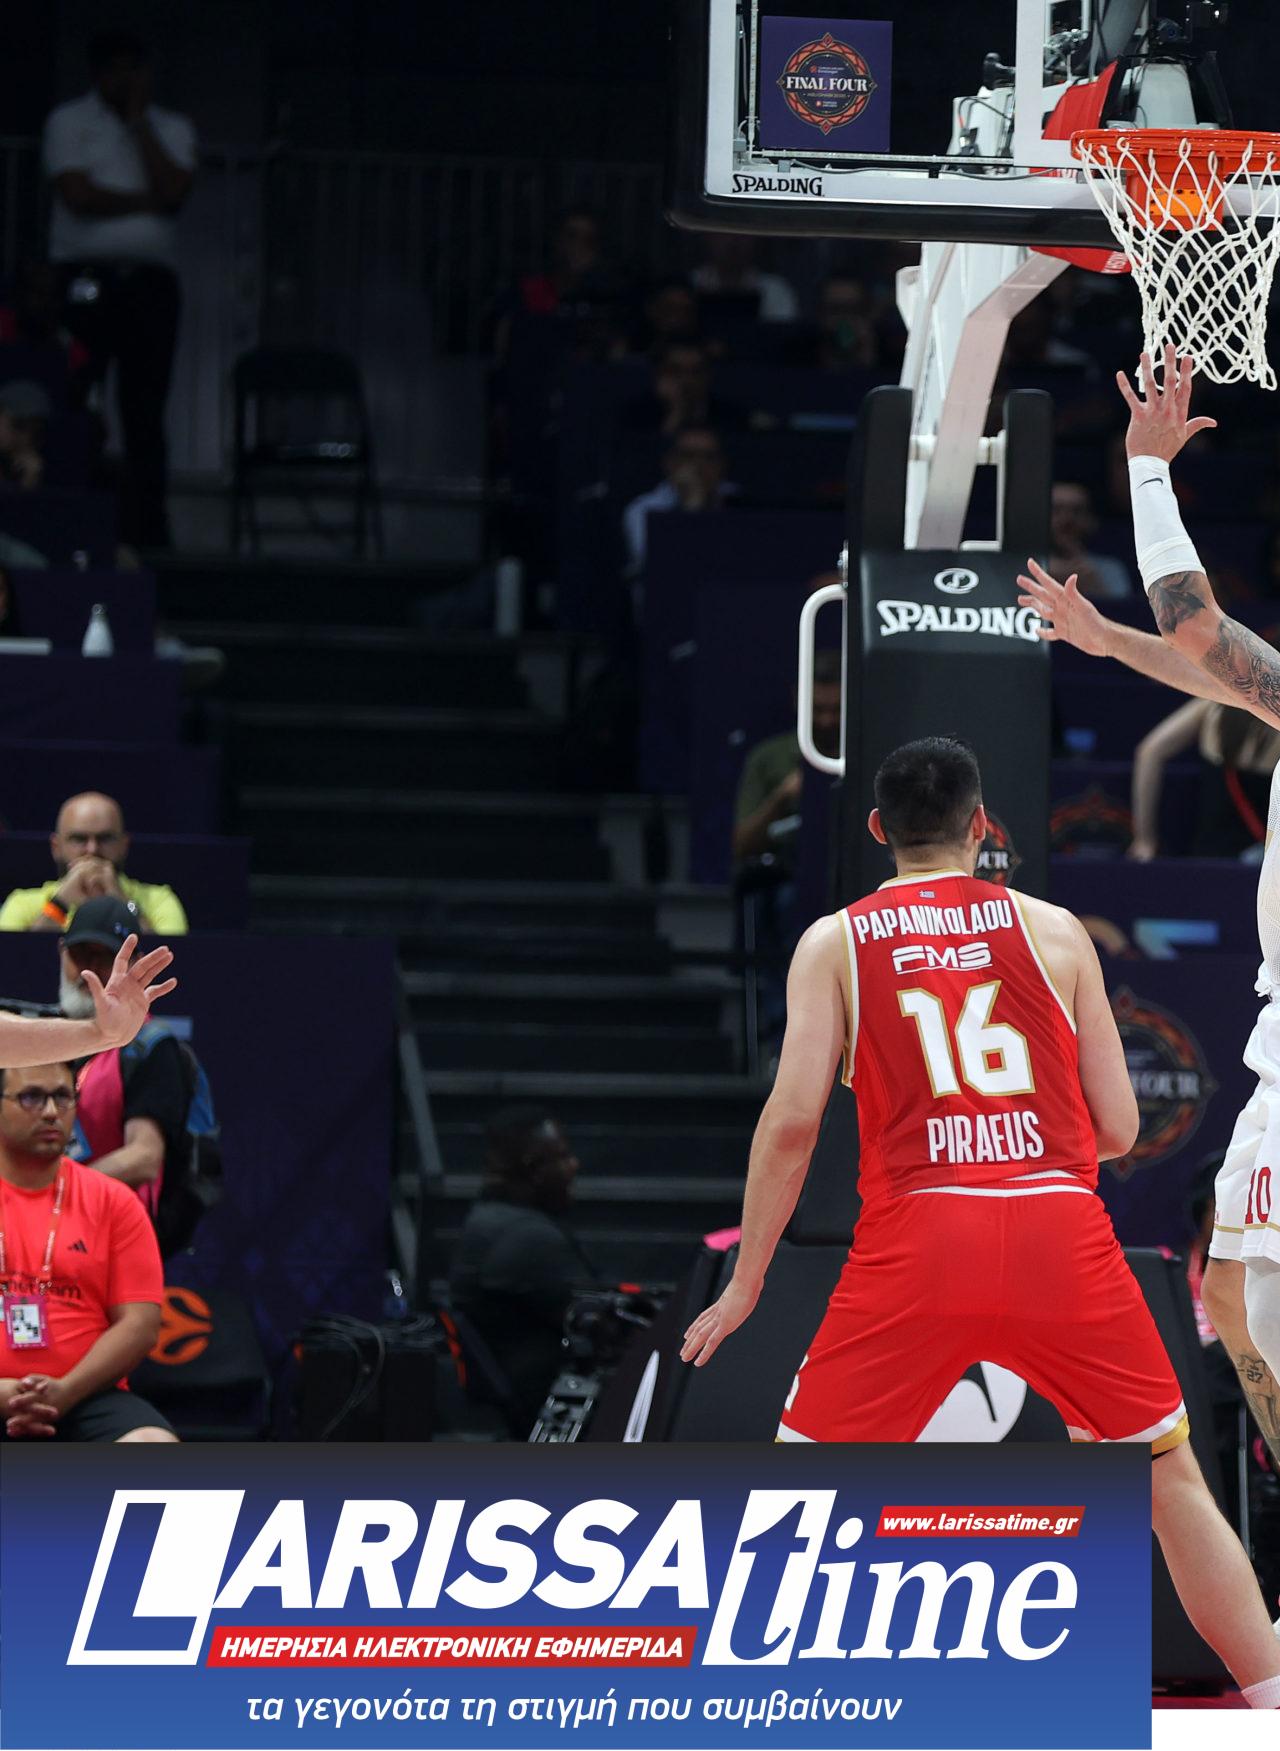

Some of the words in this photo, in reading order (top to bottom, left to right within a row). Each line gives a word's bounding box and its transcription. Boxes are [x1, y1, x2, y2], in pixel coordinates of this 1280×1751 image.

[786, 76, 827, 91] FINAL
[828, 78, 868, 92] FOUR
[732, 173, 823, 197] SPALDING
[876, 600, 1042, 642] SPALDING
[852, 899, 1014, 945] PAPANIKOLAOU
[891, 941, 994, 974] FMS
[896, 979, 1037, 1100] 16
[926, 1110, 1045, 1164] PIRAEUS
[1245, 1166, 1272, 1225] 10
